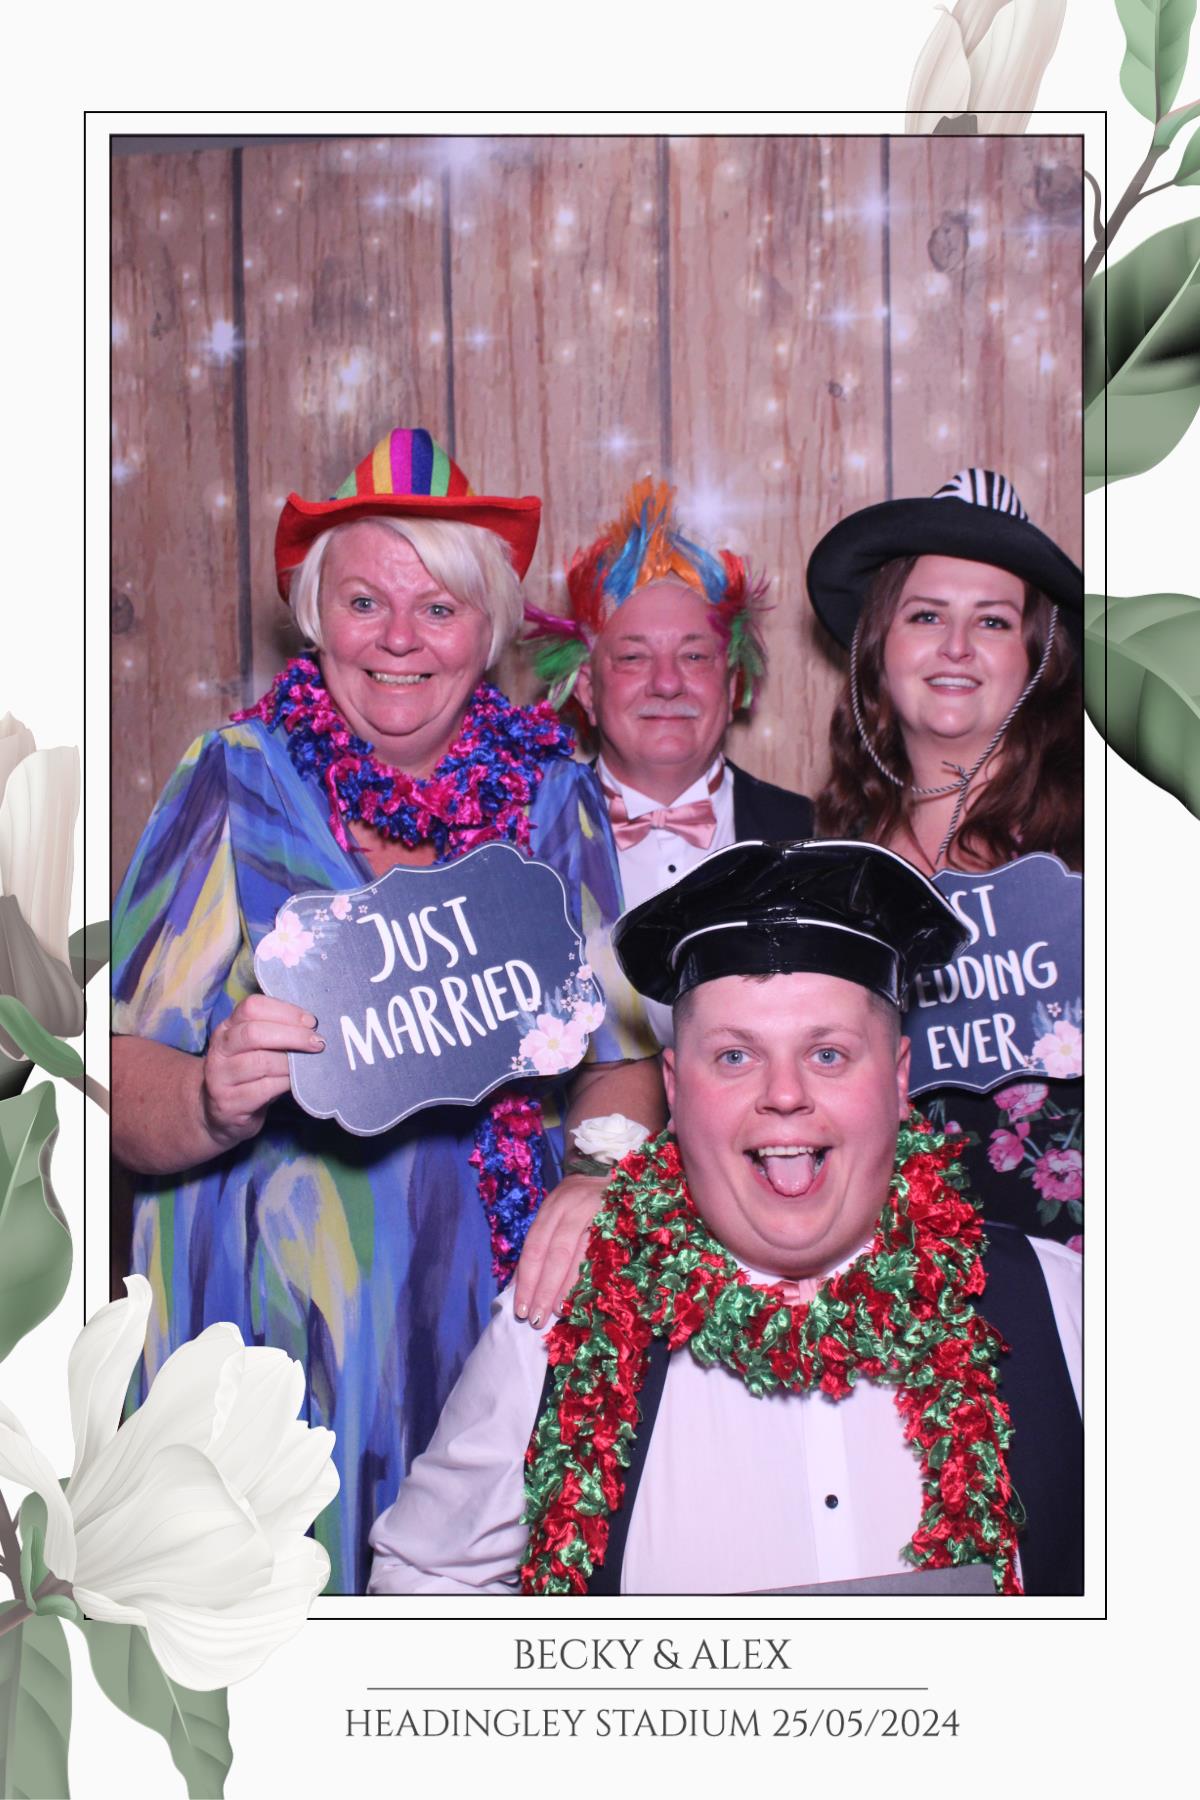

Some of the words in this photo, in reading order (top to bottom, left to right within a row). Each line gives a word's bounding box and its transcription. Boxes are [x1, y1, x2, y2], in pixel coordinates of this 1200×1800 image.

[356, 896, 478, 983] JUST
[945, 884, 998, 946] ST
[914, 941, 1059, 1008] EDDING
[340, 959, 543, 1071] MARRIED
[926, 1013, 1028, 1071] EVER
